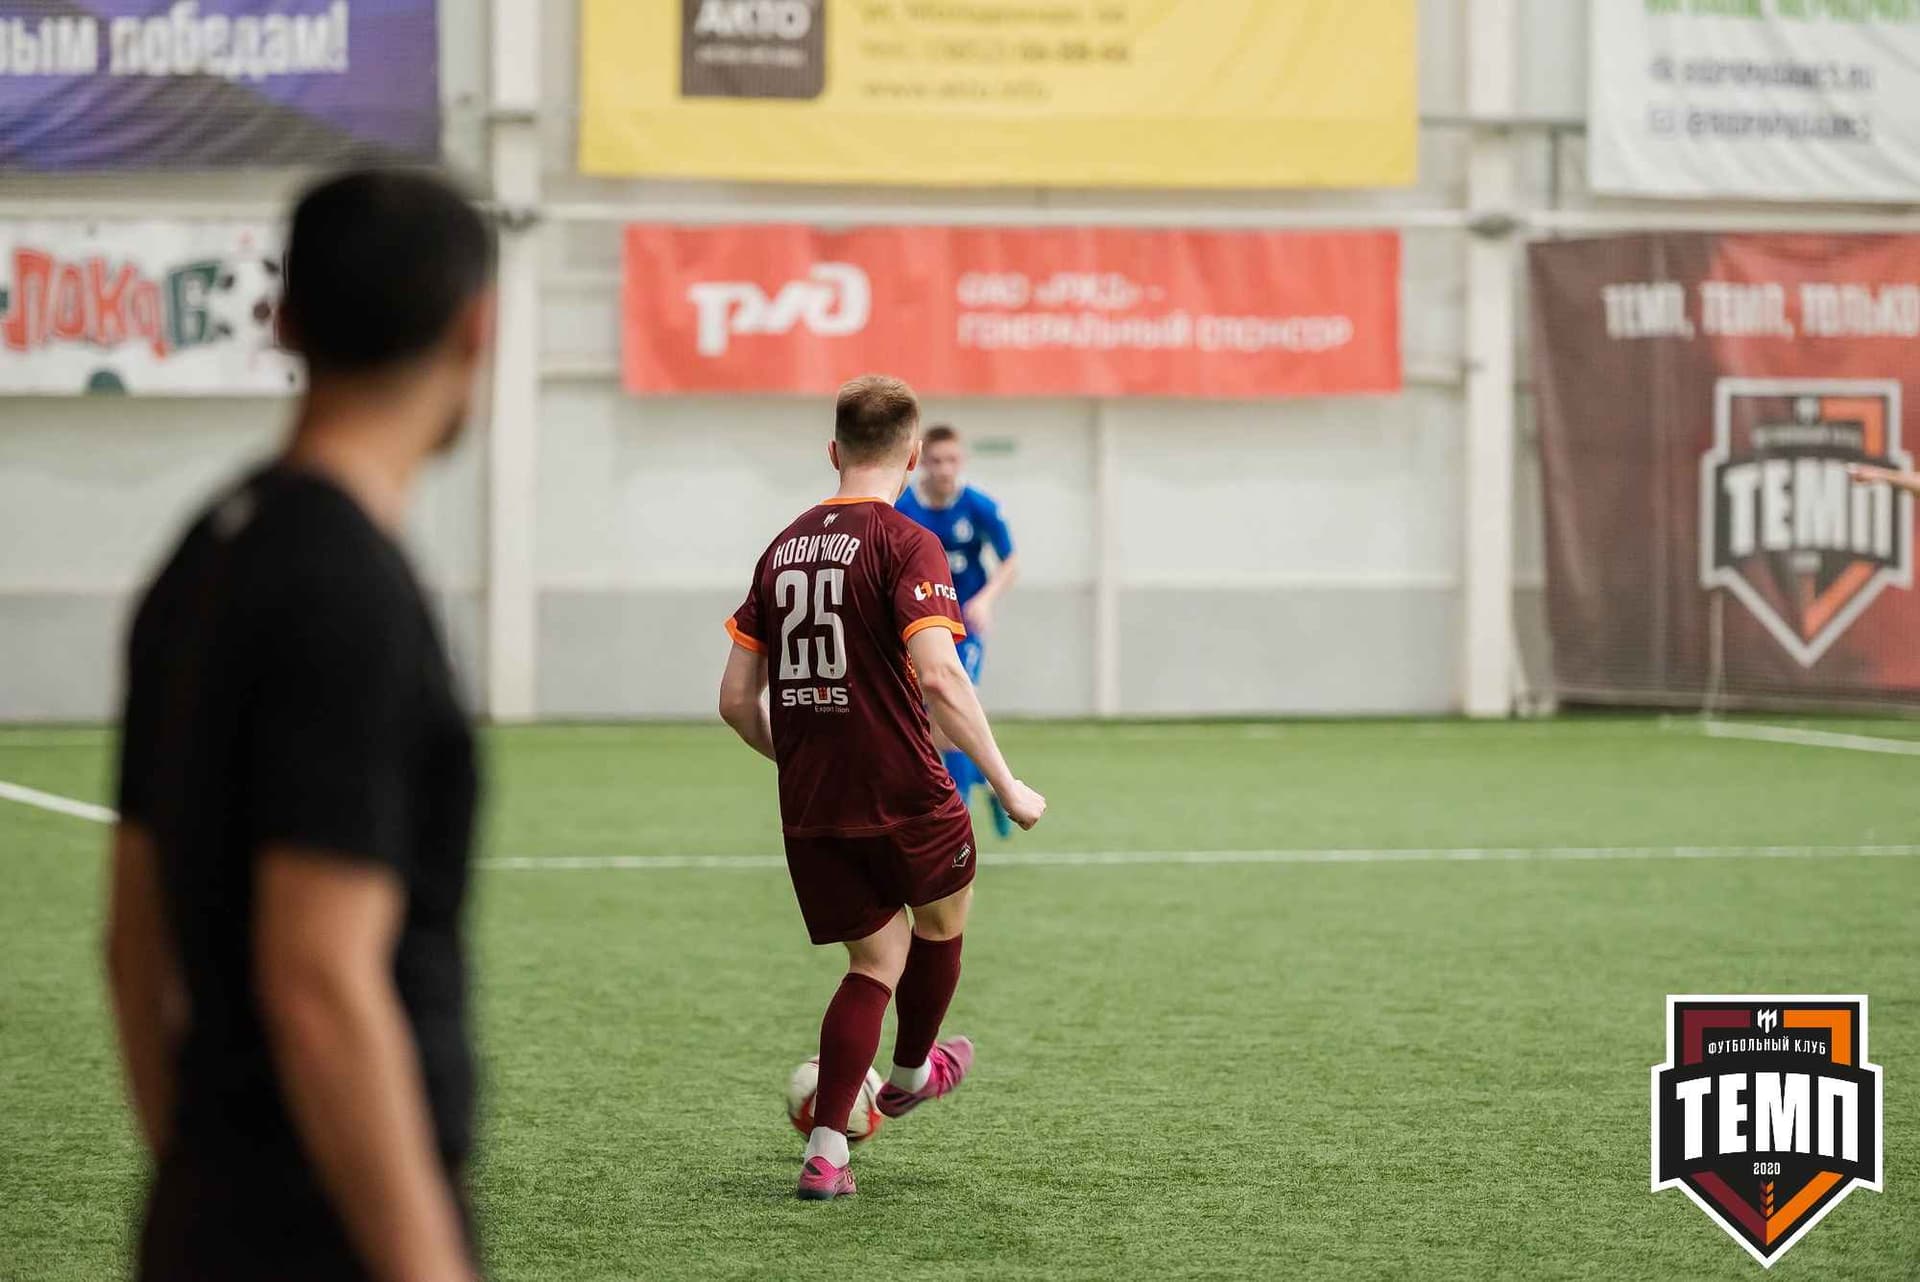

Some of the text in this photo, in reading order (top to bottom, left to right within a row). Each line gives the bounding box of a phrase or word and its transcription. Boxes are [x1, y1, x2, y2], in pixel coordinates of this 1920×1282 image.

[110, 0, 349, 82] победам!
[687, 262, 872, 357] РЖД
[1723, 458, 1893, 557] ТЕМП
[772, 533, 861, 570] НОВИЧКОВ
[934, 583, 957, 601] ПСБ
[775, 568, 848, 680] 25
[781, 686, 849, 707] SEUS
